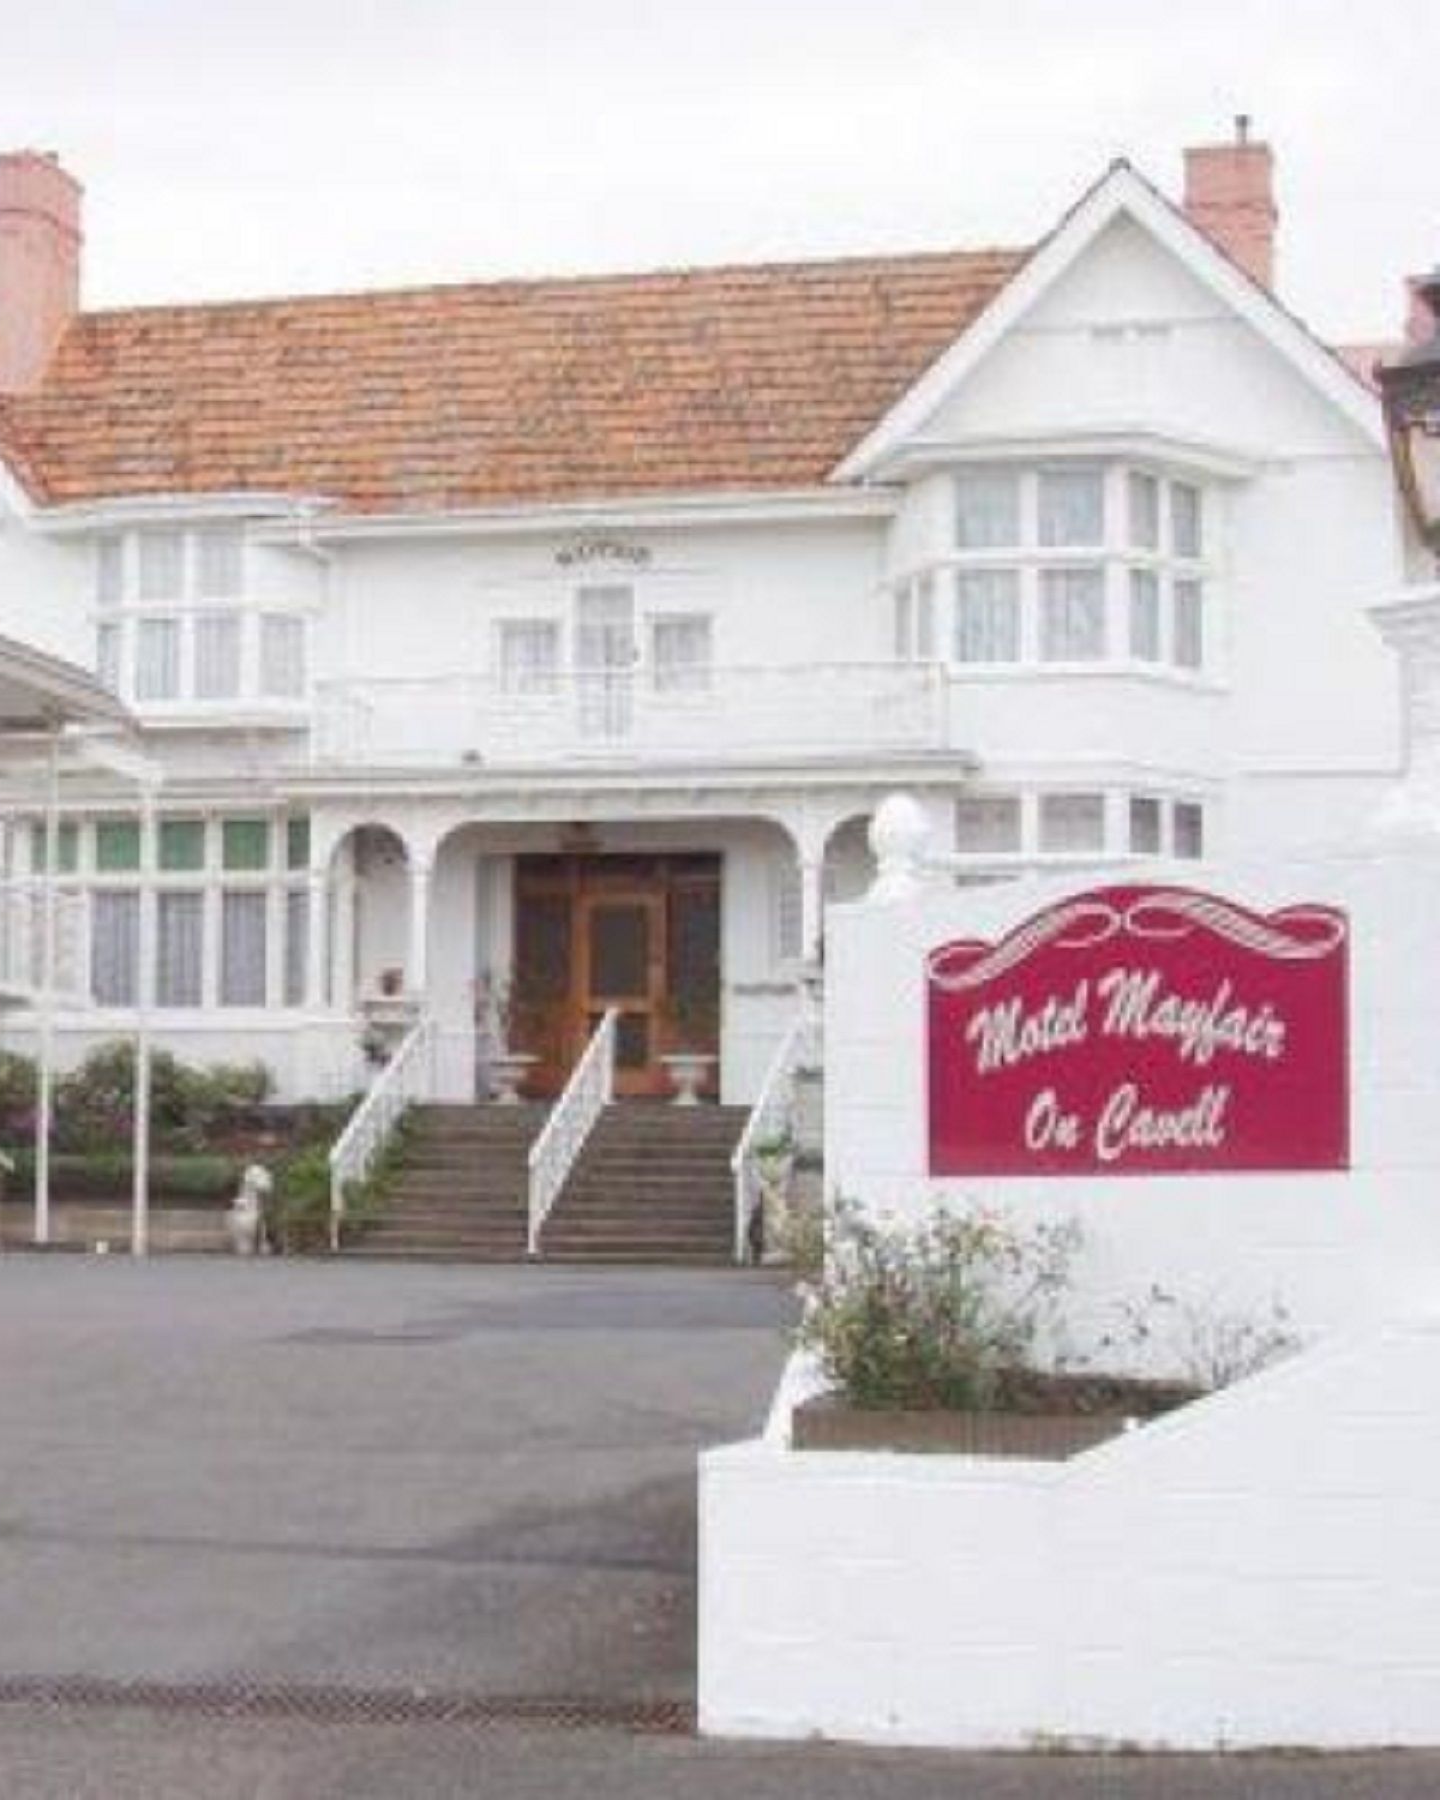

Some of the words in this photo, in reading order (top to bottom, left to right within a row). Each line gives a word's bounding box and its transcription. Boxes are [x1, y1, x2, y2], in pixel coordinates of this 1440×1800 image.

[966, 979, 1088, 1075] Motel
[1097, 967, 1286, 1066] Mayfair
[1025, 1087, 1081, 1151] On
[1096, 1083, 1232, 1161] Cavell
